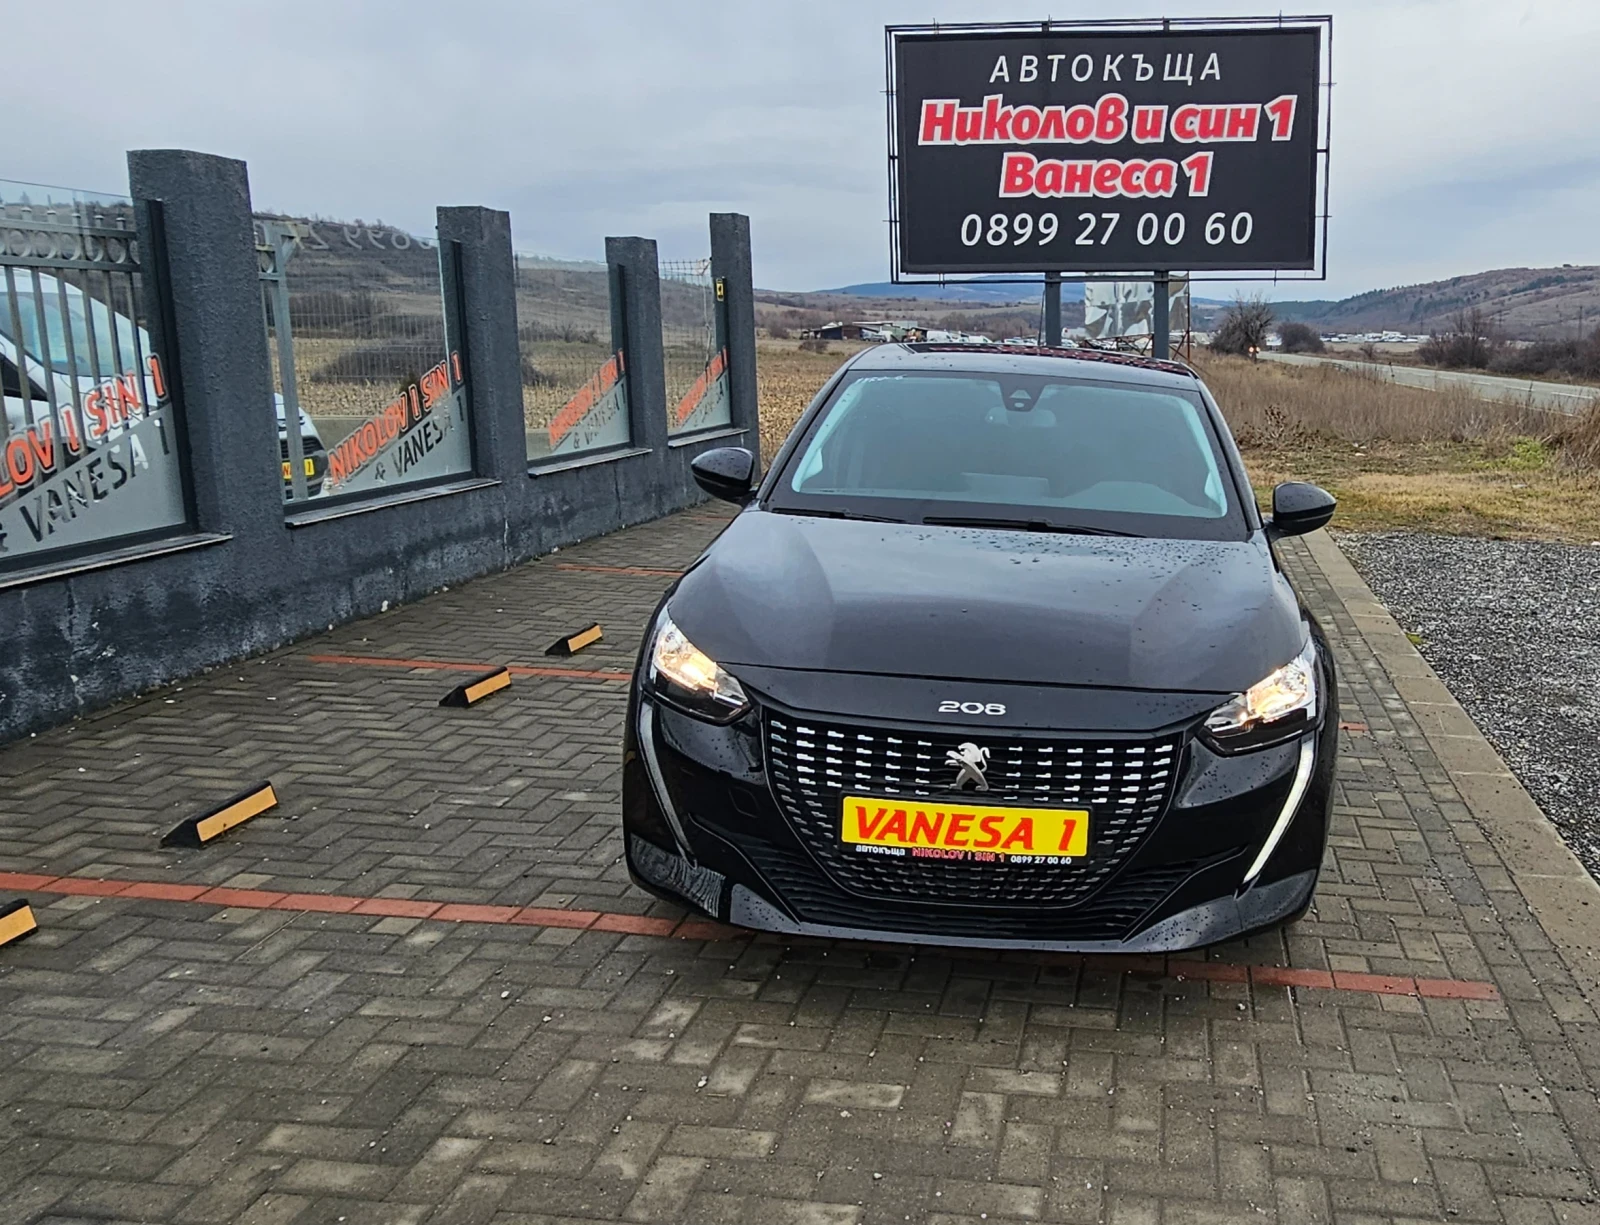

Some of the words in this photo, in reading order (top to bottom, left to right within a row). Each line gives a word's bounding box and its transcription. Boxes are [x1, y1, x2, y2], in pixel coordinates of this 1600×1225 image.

[989, 53, 1222, 86] АВТОКЪЩА
[918, 93, 1128, 145] Николов
[1132, 105, 1168, 144] и
[1170, 104, 1262, 143] син
[1263, 95, 1297, 141] 1
[999, 152, 1178, 198] Ванеса
[1181, 152, 1214, 197] 1
[961, 213, 1059, 247] 0899
[1076, 213, 1120, 246] 27
[1136, 212, 1186, 246] 00
[1205, 211, 1253, 245] 60
[83, 371, 143, 440] SIN
[147, 353, 168, 400] 1
[327, 393, 408, 486] NIKOLOV
[20, 434, 149, 542] VANESA
[938, 700, 1006, 716] 208
[856, 806, 1034, 850] VANESA
[1058, 819, 1077, 851] 1
[855, 844, 906, 857] автокъща
[911, 847, 965, 860] NIKOLOV
[974, 851, 995, 862] SIN
[1010, 855, 1032, 864] 0899
[1034, 856, 1046, 865] 27
[1047, 857, 1059, 865] 00
[1060, 857, 1072, 865] 60
